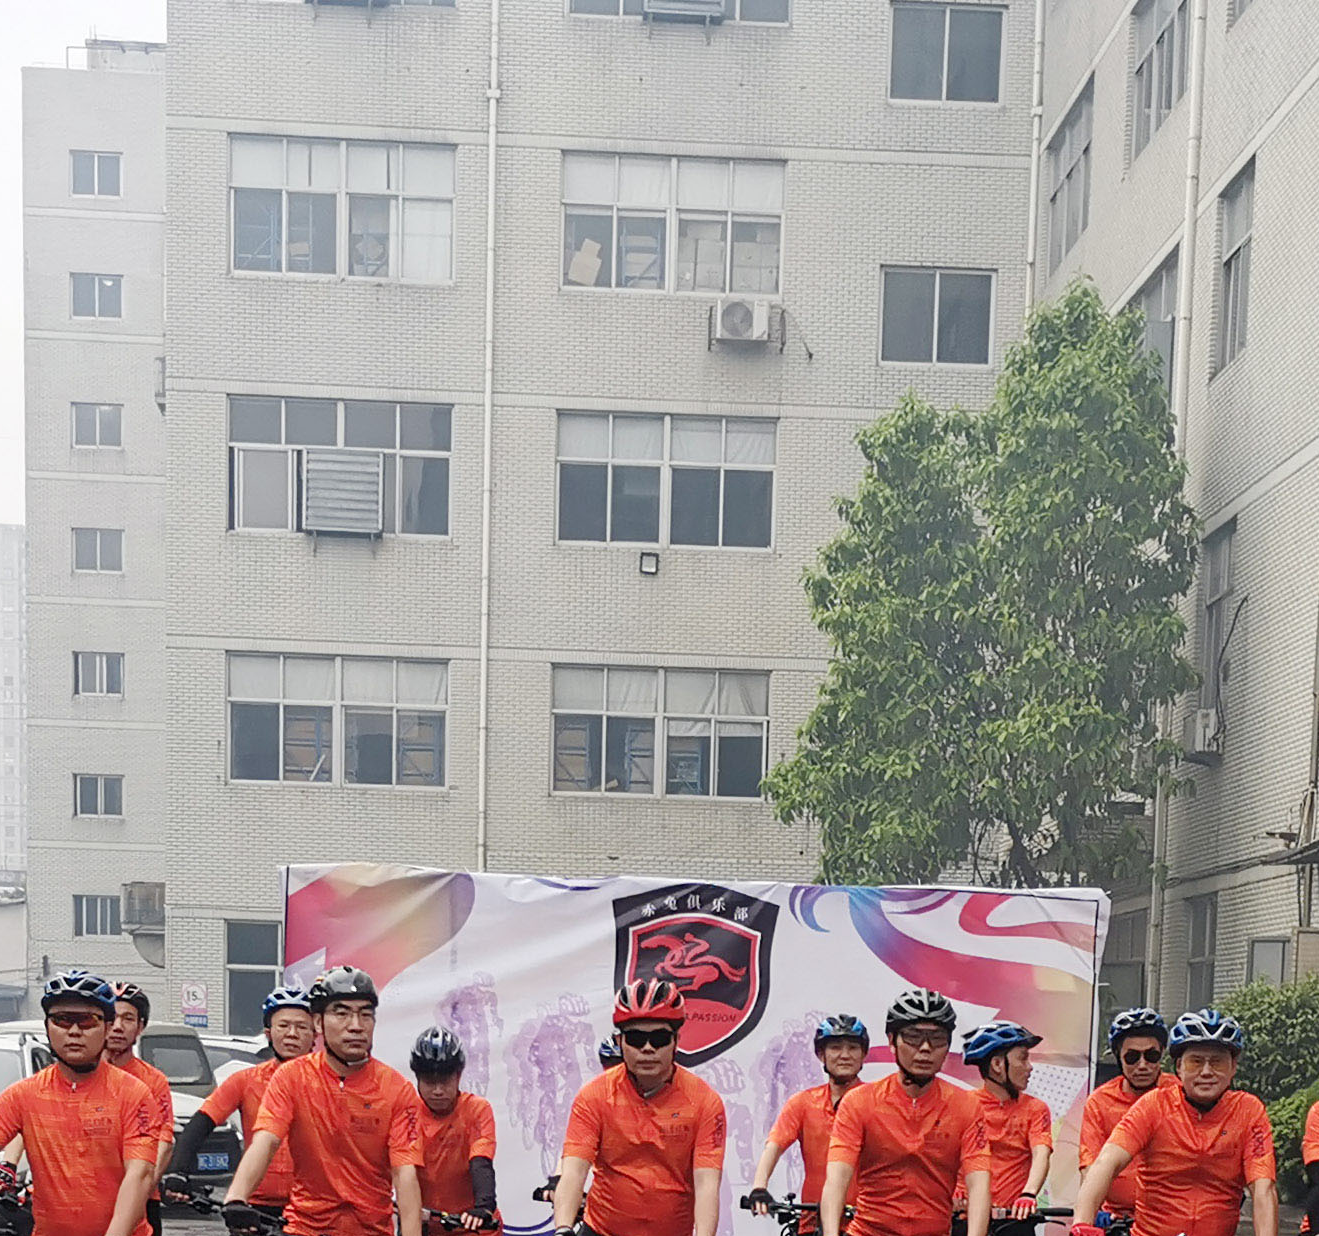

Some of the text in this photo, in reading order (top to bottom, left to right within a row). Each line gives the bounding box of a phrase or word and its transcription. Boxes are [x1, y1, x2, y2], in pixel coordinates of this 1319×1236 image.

[642, 893, 748, 922] 赤兔俱乐部
